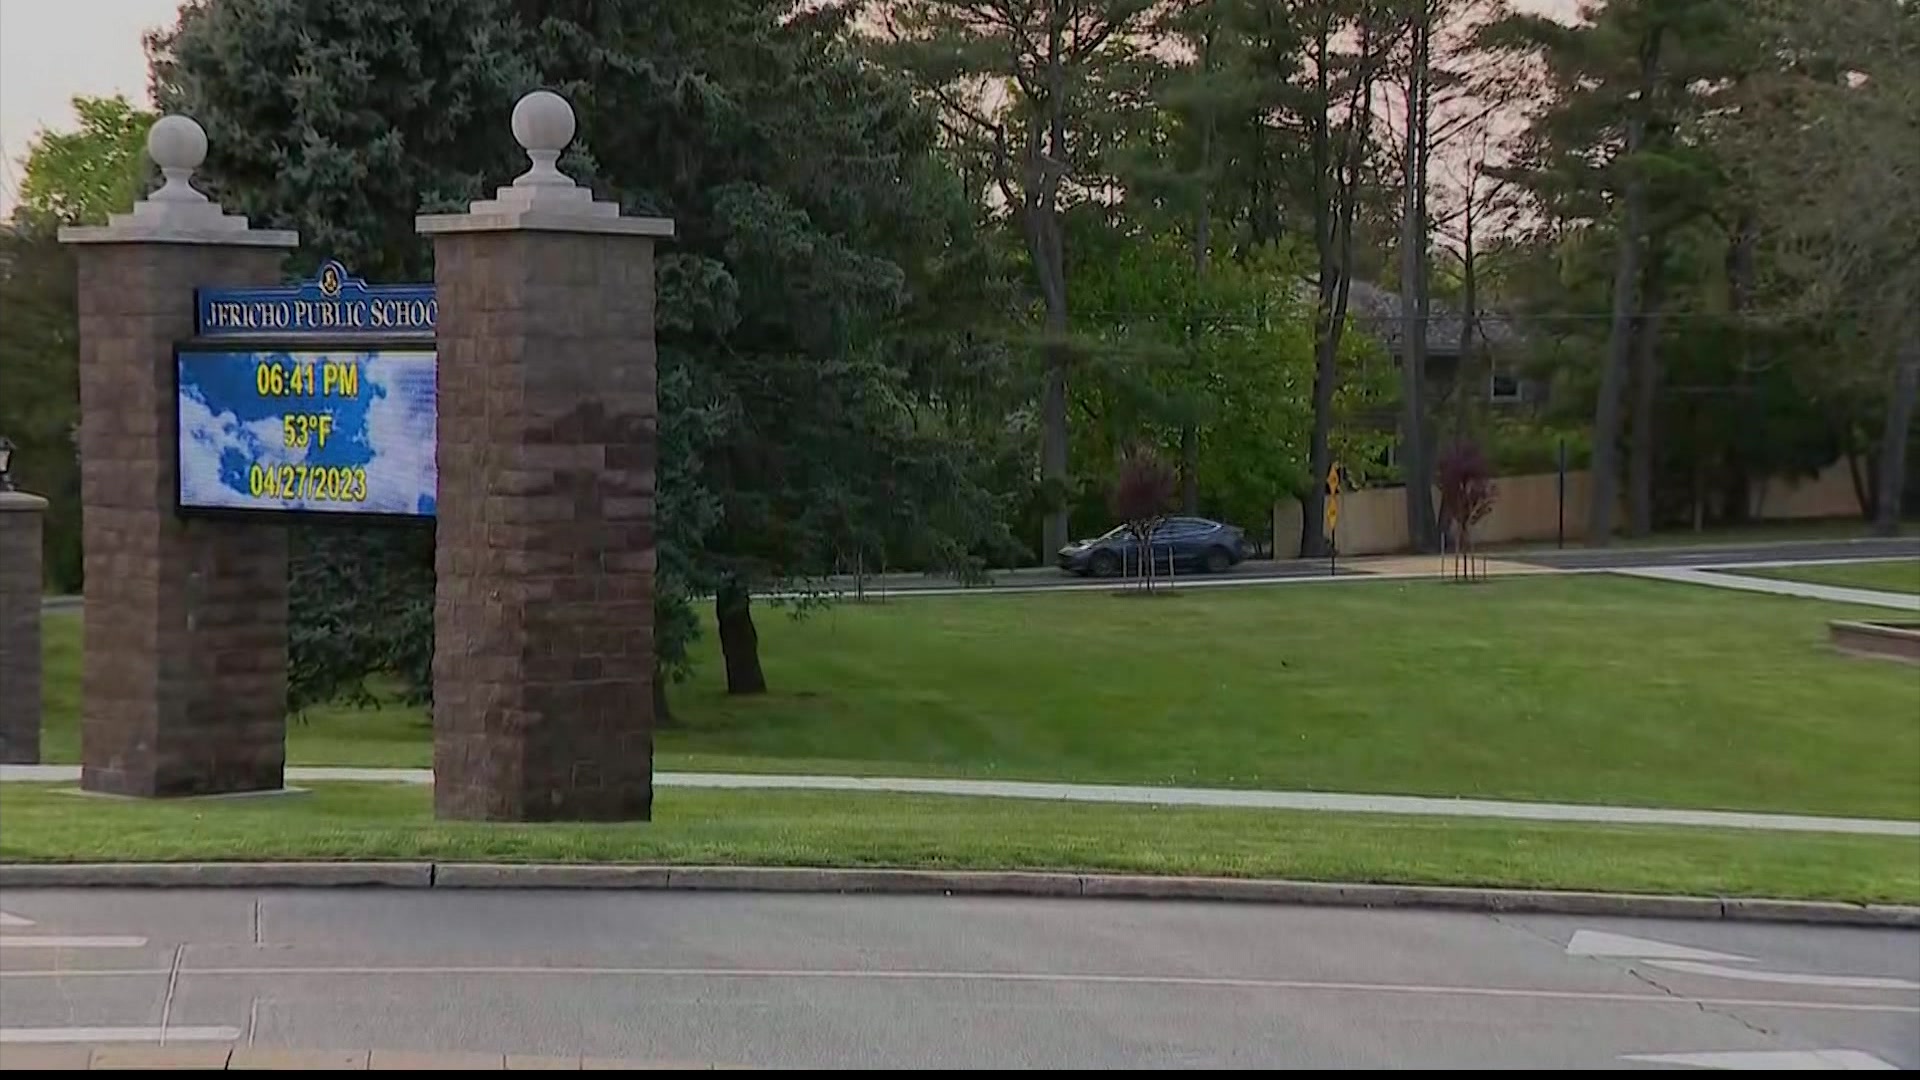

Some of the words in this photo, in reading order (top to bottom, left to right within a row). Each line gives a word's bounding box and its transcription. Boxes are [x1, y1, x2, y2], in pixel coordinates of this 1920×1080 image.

[207, 301, 290, 328] JERICHO
[295, 301, 366, 328] PUBLIC
[257, 363, 315, 395] 06:41
[323, 363, 358, 395] PM
[283, 414, 333, 448] 53°F
[250, 465, 366, 500] 04/27/2023
